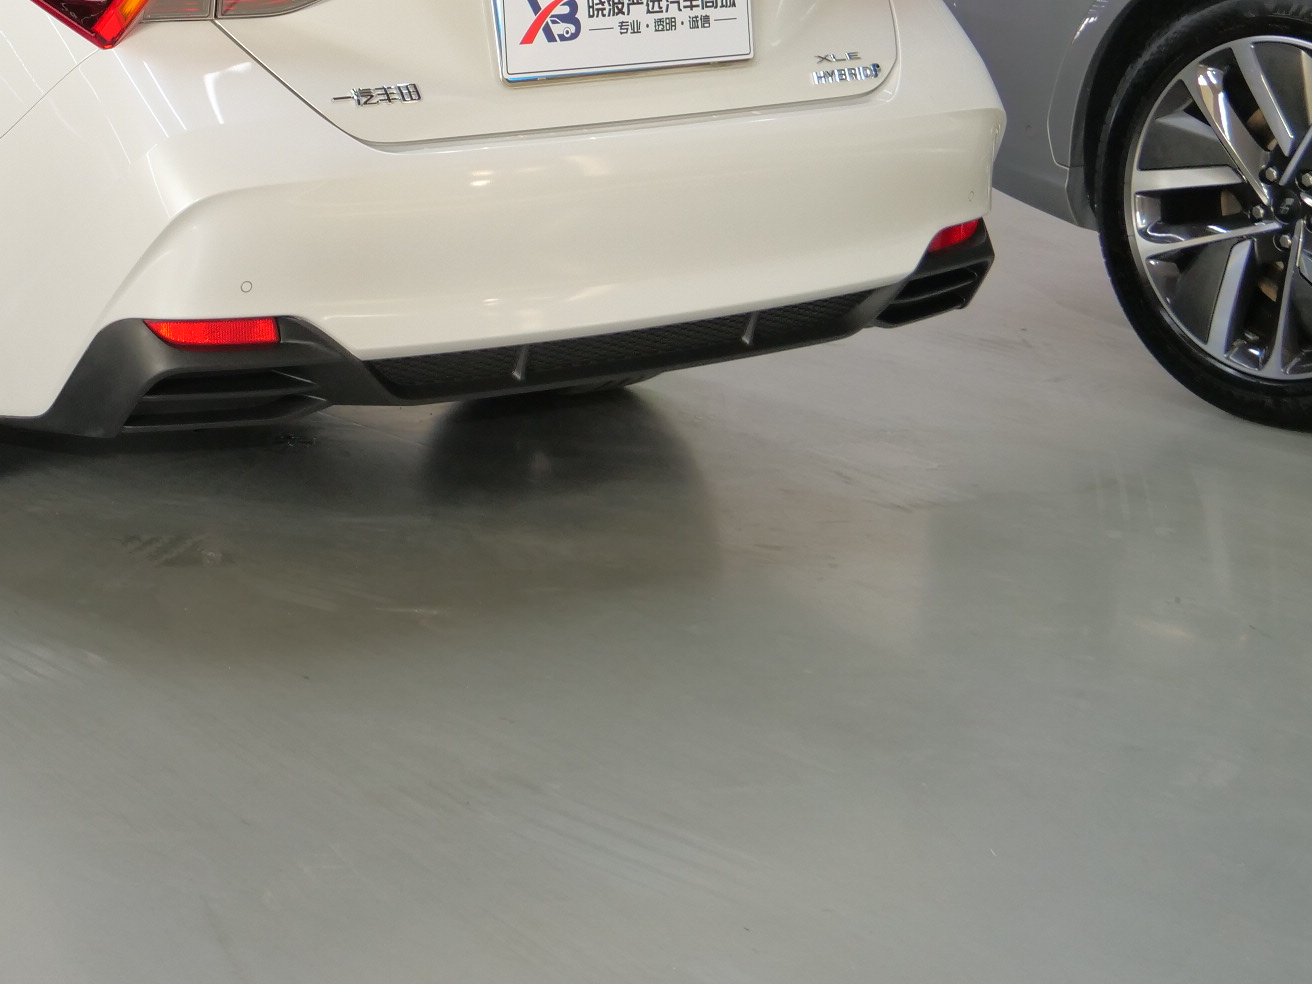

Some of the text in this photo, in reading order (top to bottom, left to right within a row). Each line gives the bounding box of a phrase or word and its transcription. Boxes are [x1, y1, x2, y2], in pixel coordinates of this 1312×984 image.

[814, 51, 861, 64] XLE
[811, 66, 874, 85] HYBRID
[331, 82, 421, 106] 一汽丰田
